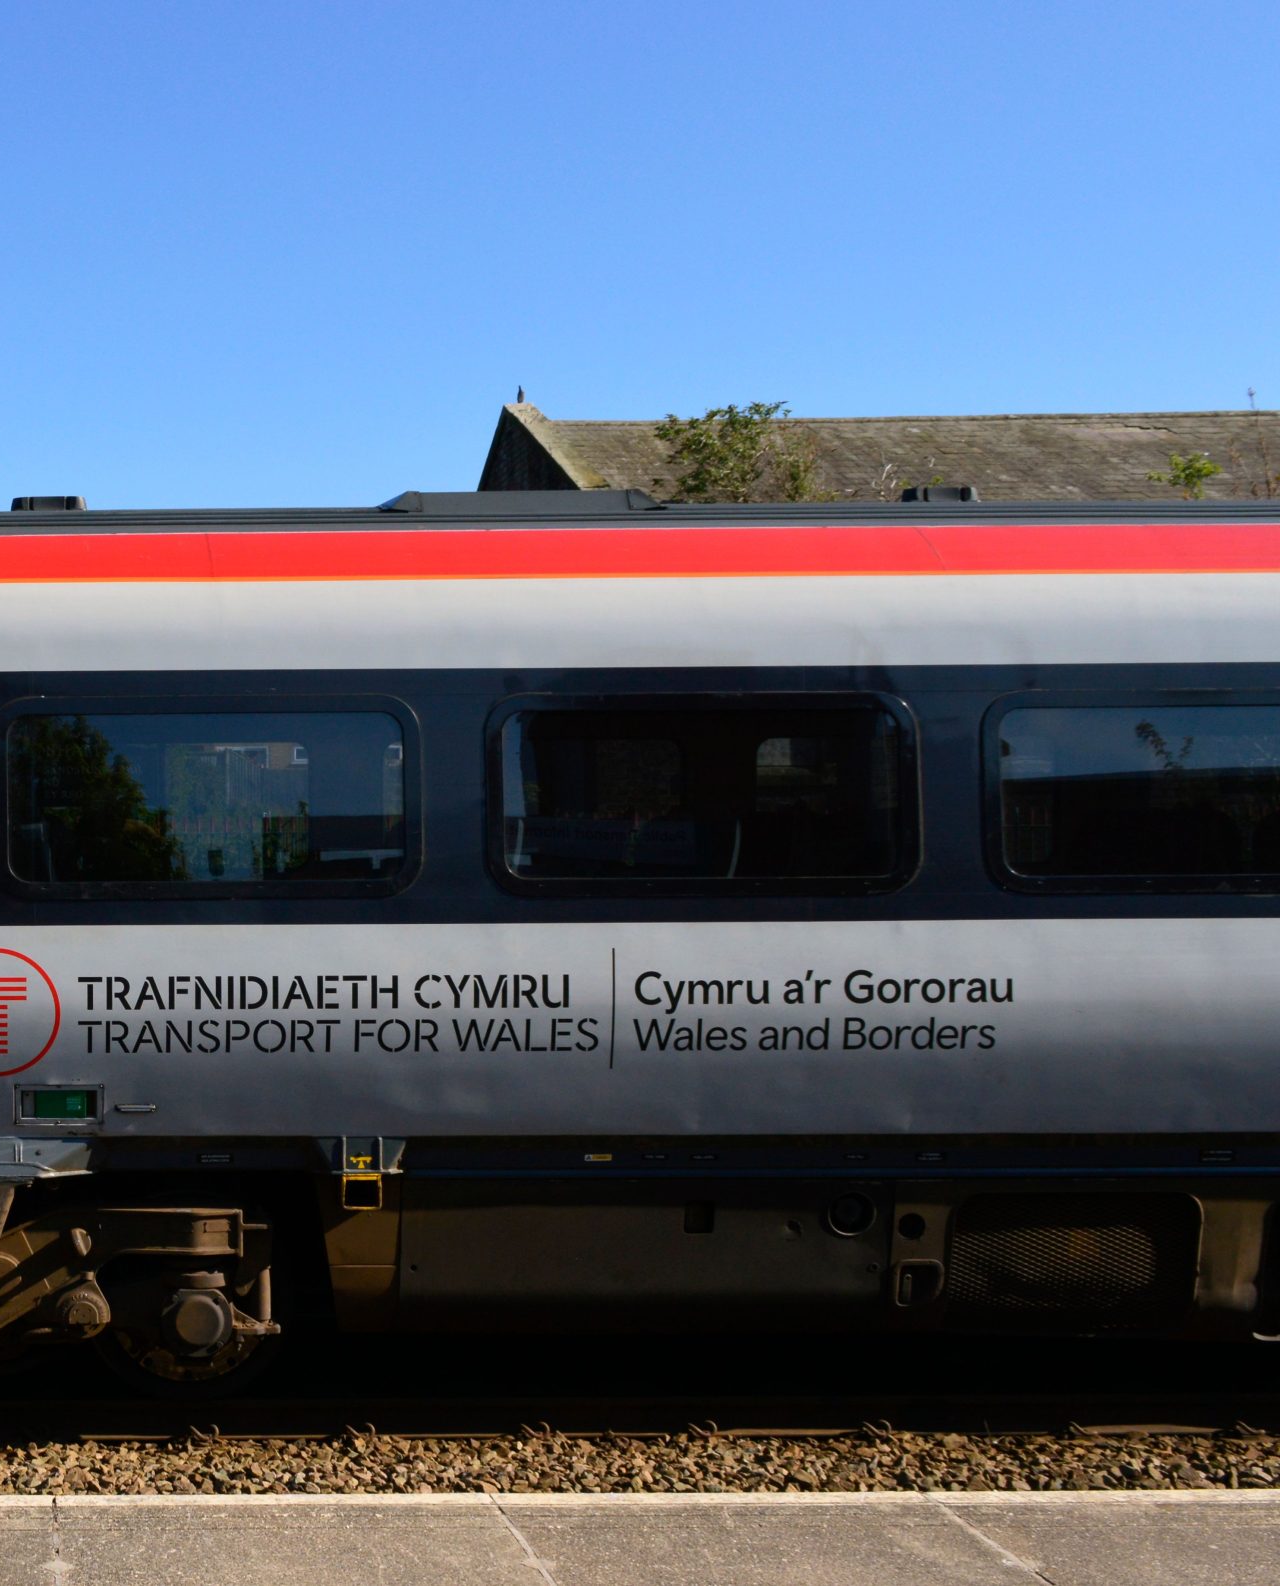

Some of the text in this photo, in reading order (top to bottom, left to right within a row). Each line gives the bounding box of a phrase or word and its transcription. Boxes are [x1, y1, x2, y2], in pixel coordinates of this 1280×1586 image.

[77, 973, 571, 1010] TRAFNIDIAETH CYMRU
[633, 970, 770, 1015] Cymru
[843, 969, 1015, 1005] Gororau
[77, 1017, 600, 1055] TRANSPORT FOR WALES
[632, 1016, 996, 1052] Wales and Borders
